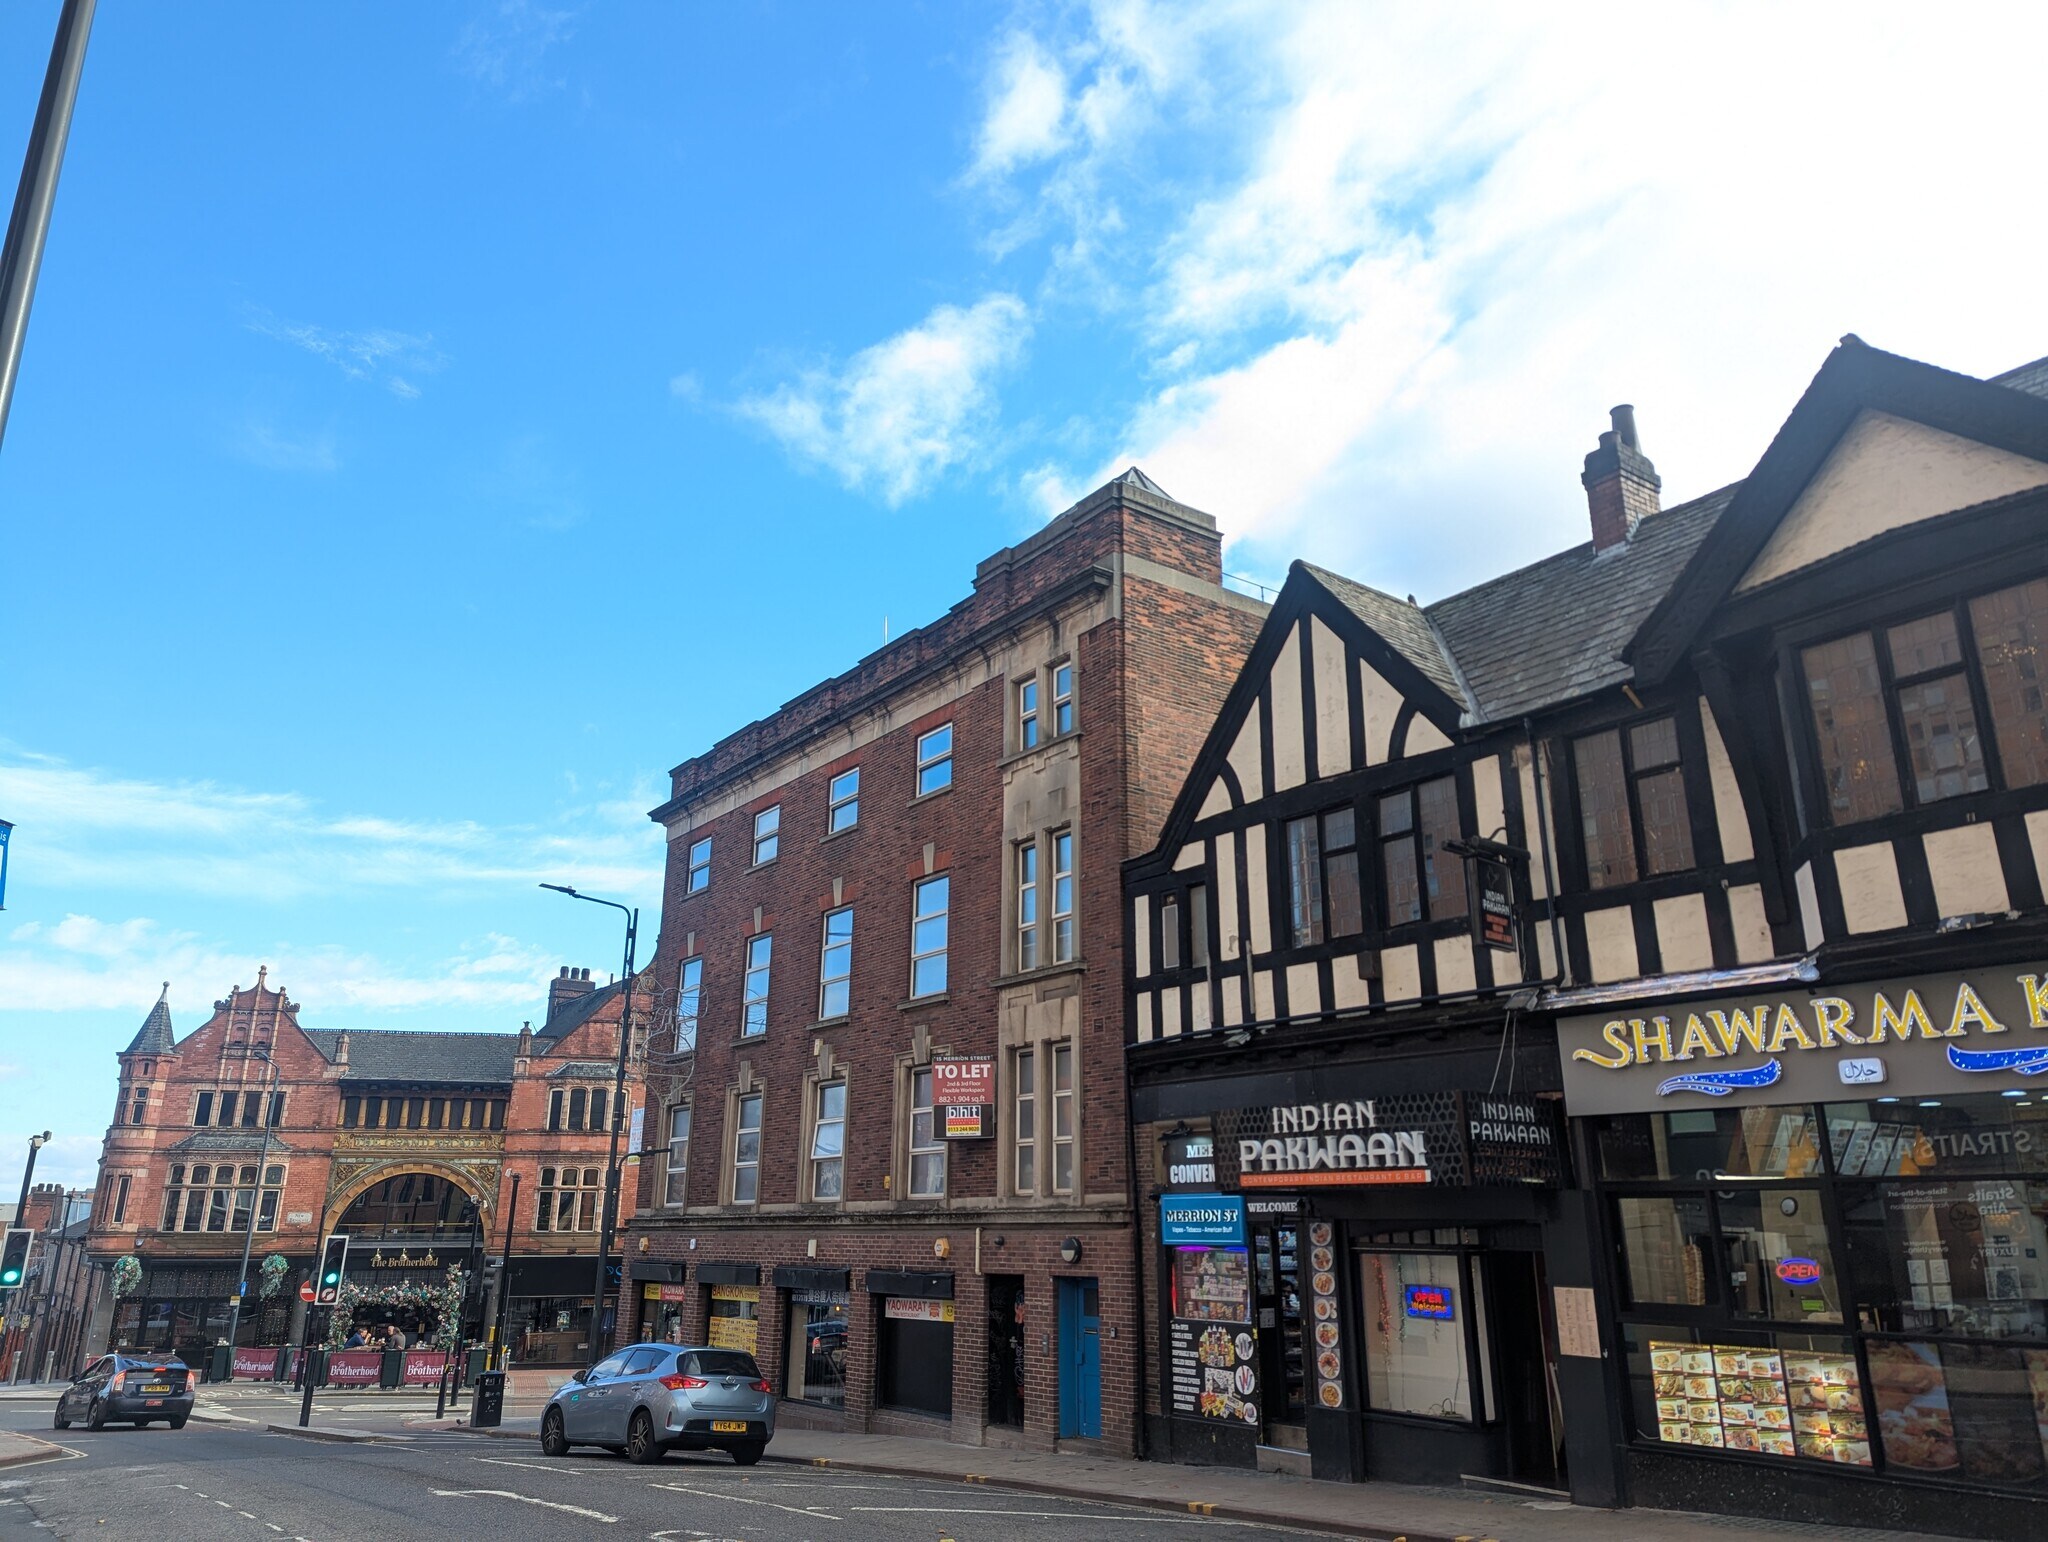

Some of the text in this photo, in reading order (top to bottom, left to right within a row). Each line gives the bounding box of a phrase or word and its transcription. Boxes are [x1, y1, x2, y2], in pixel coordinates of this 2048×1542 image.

[1485, 889, 1505, 904] INDIAN
[1482, 899, 1510, 916] PAKWAAN
[1573, 982, 2007, 1069] SHAWARMA
[935, 1064, 991, 1078] TO LET
[1845, 1061, 1877, 1078] حلال
[1272, 1100, 1376, 1134] INDIAN
[1482, 1102, 1535, 1123] INDIAN
[1470, 1121, 1551, 1145] PAKWAAN
[1239, 1131, 1428, 1172] PAKWAAN
[1243, 1176, 1304, 1184] CONTEMPORARY
[1335, 1173, 1392, 1182] RESTAURANT
[1404, 1172, 1422, 1180] BAR
[1247, 1202, 1298, 1213] WELCOME
[1167, 1209, 1238, 1222] MERRION ST
[371, 1257, 439, 1268] The Brotherhood
[1776, 1264, 1820, 1278] OPEN
[713, 1285, 744, 1298] BANGKOK
[1414, 1292, 1442, 1303] OPEN
[886, 1300, 927, 1312] YAOWARAT
[1411, 1301, 1447, 1312] Welcome
[234, 1360, 273, 1371] Brotherhood
[330, 1365, 379, 1376] Brotherhood
[714, 1421, 731, 1429] YY64
